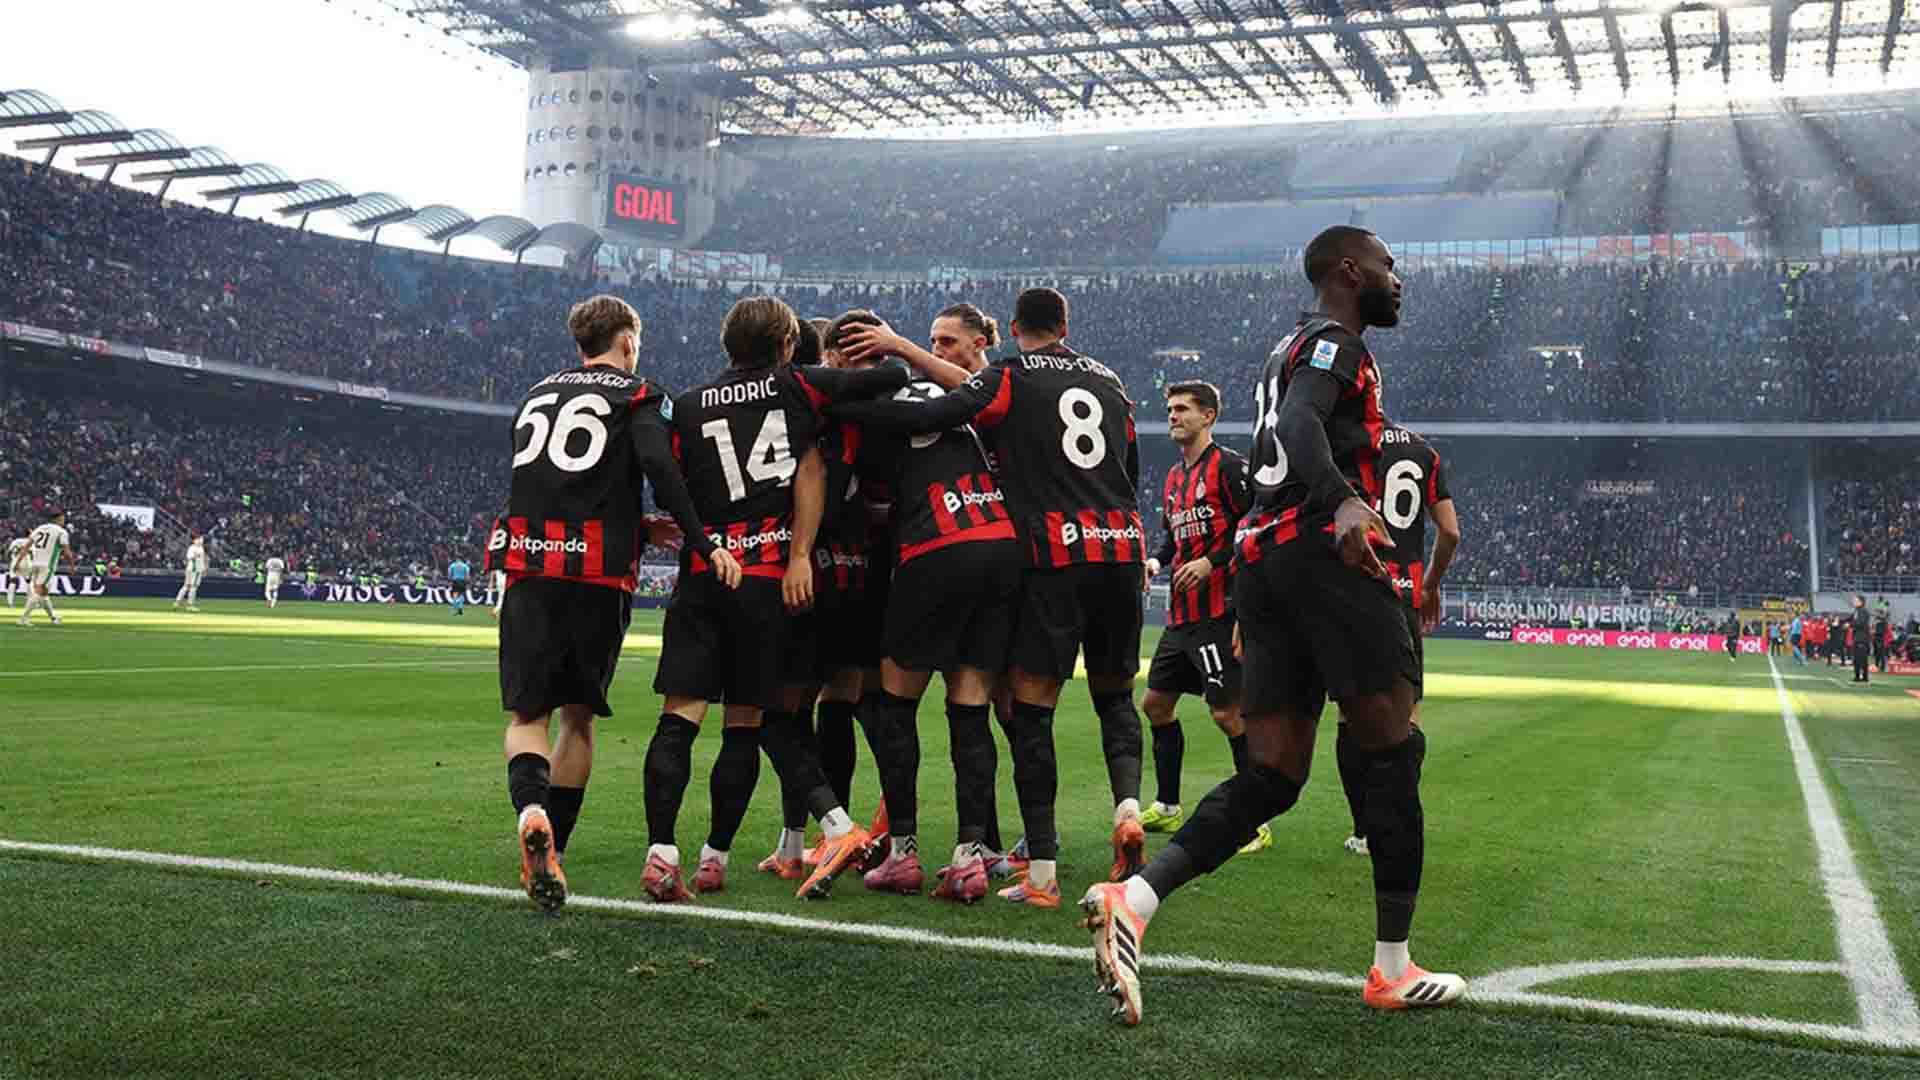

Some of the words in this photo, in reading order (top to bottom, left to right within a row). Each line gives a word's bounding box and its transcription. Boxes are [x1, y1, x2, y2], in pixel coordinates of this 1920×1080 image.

[615, 184, 680, 224] GOAL
[701, 373, 778, 408] MODRIĆ
[511, 392, 611, 472] 56
[1058, 387, 1106, 469] 8
[701, 409, 797, 502] 14
[34, 532, 50, 548] 21
[509, 535, 588, 555] bitpanda
[325, 583, 394, 602] MSC
[1516, 631, 1555, 644] enel
[1567, 633, 1606, 646] enel
[1617, 634, 1656, 648] enel
[1669, 635, 1709, 649] enel
[1199, 643, 1223, 674] 11
